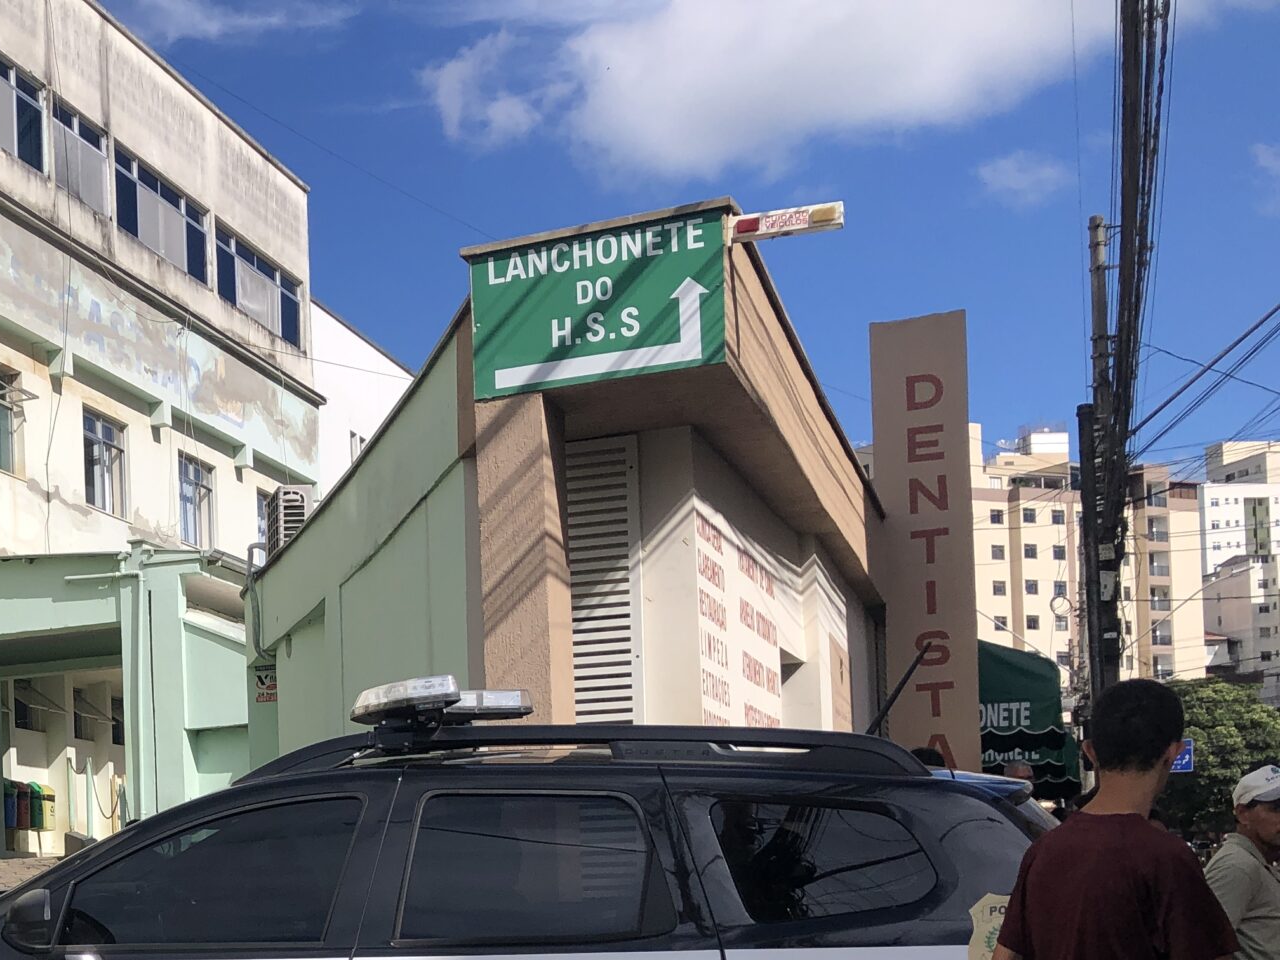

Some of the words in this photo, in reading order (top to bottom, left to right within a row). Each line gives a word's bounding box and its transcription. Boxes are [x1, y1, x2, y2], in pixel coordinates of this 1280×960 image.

[764, 210, 809, 223] CUIDADO
[487, 218, 705, 285] LANCHONETE
[576, 276, 613, 305] DO
[551, 306, 640, 348] H.S.S
[905, 373, 958, 770] DENTISTA
[700, 628, 729, 671] LIMPEZA
